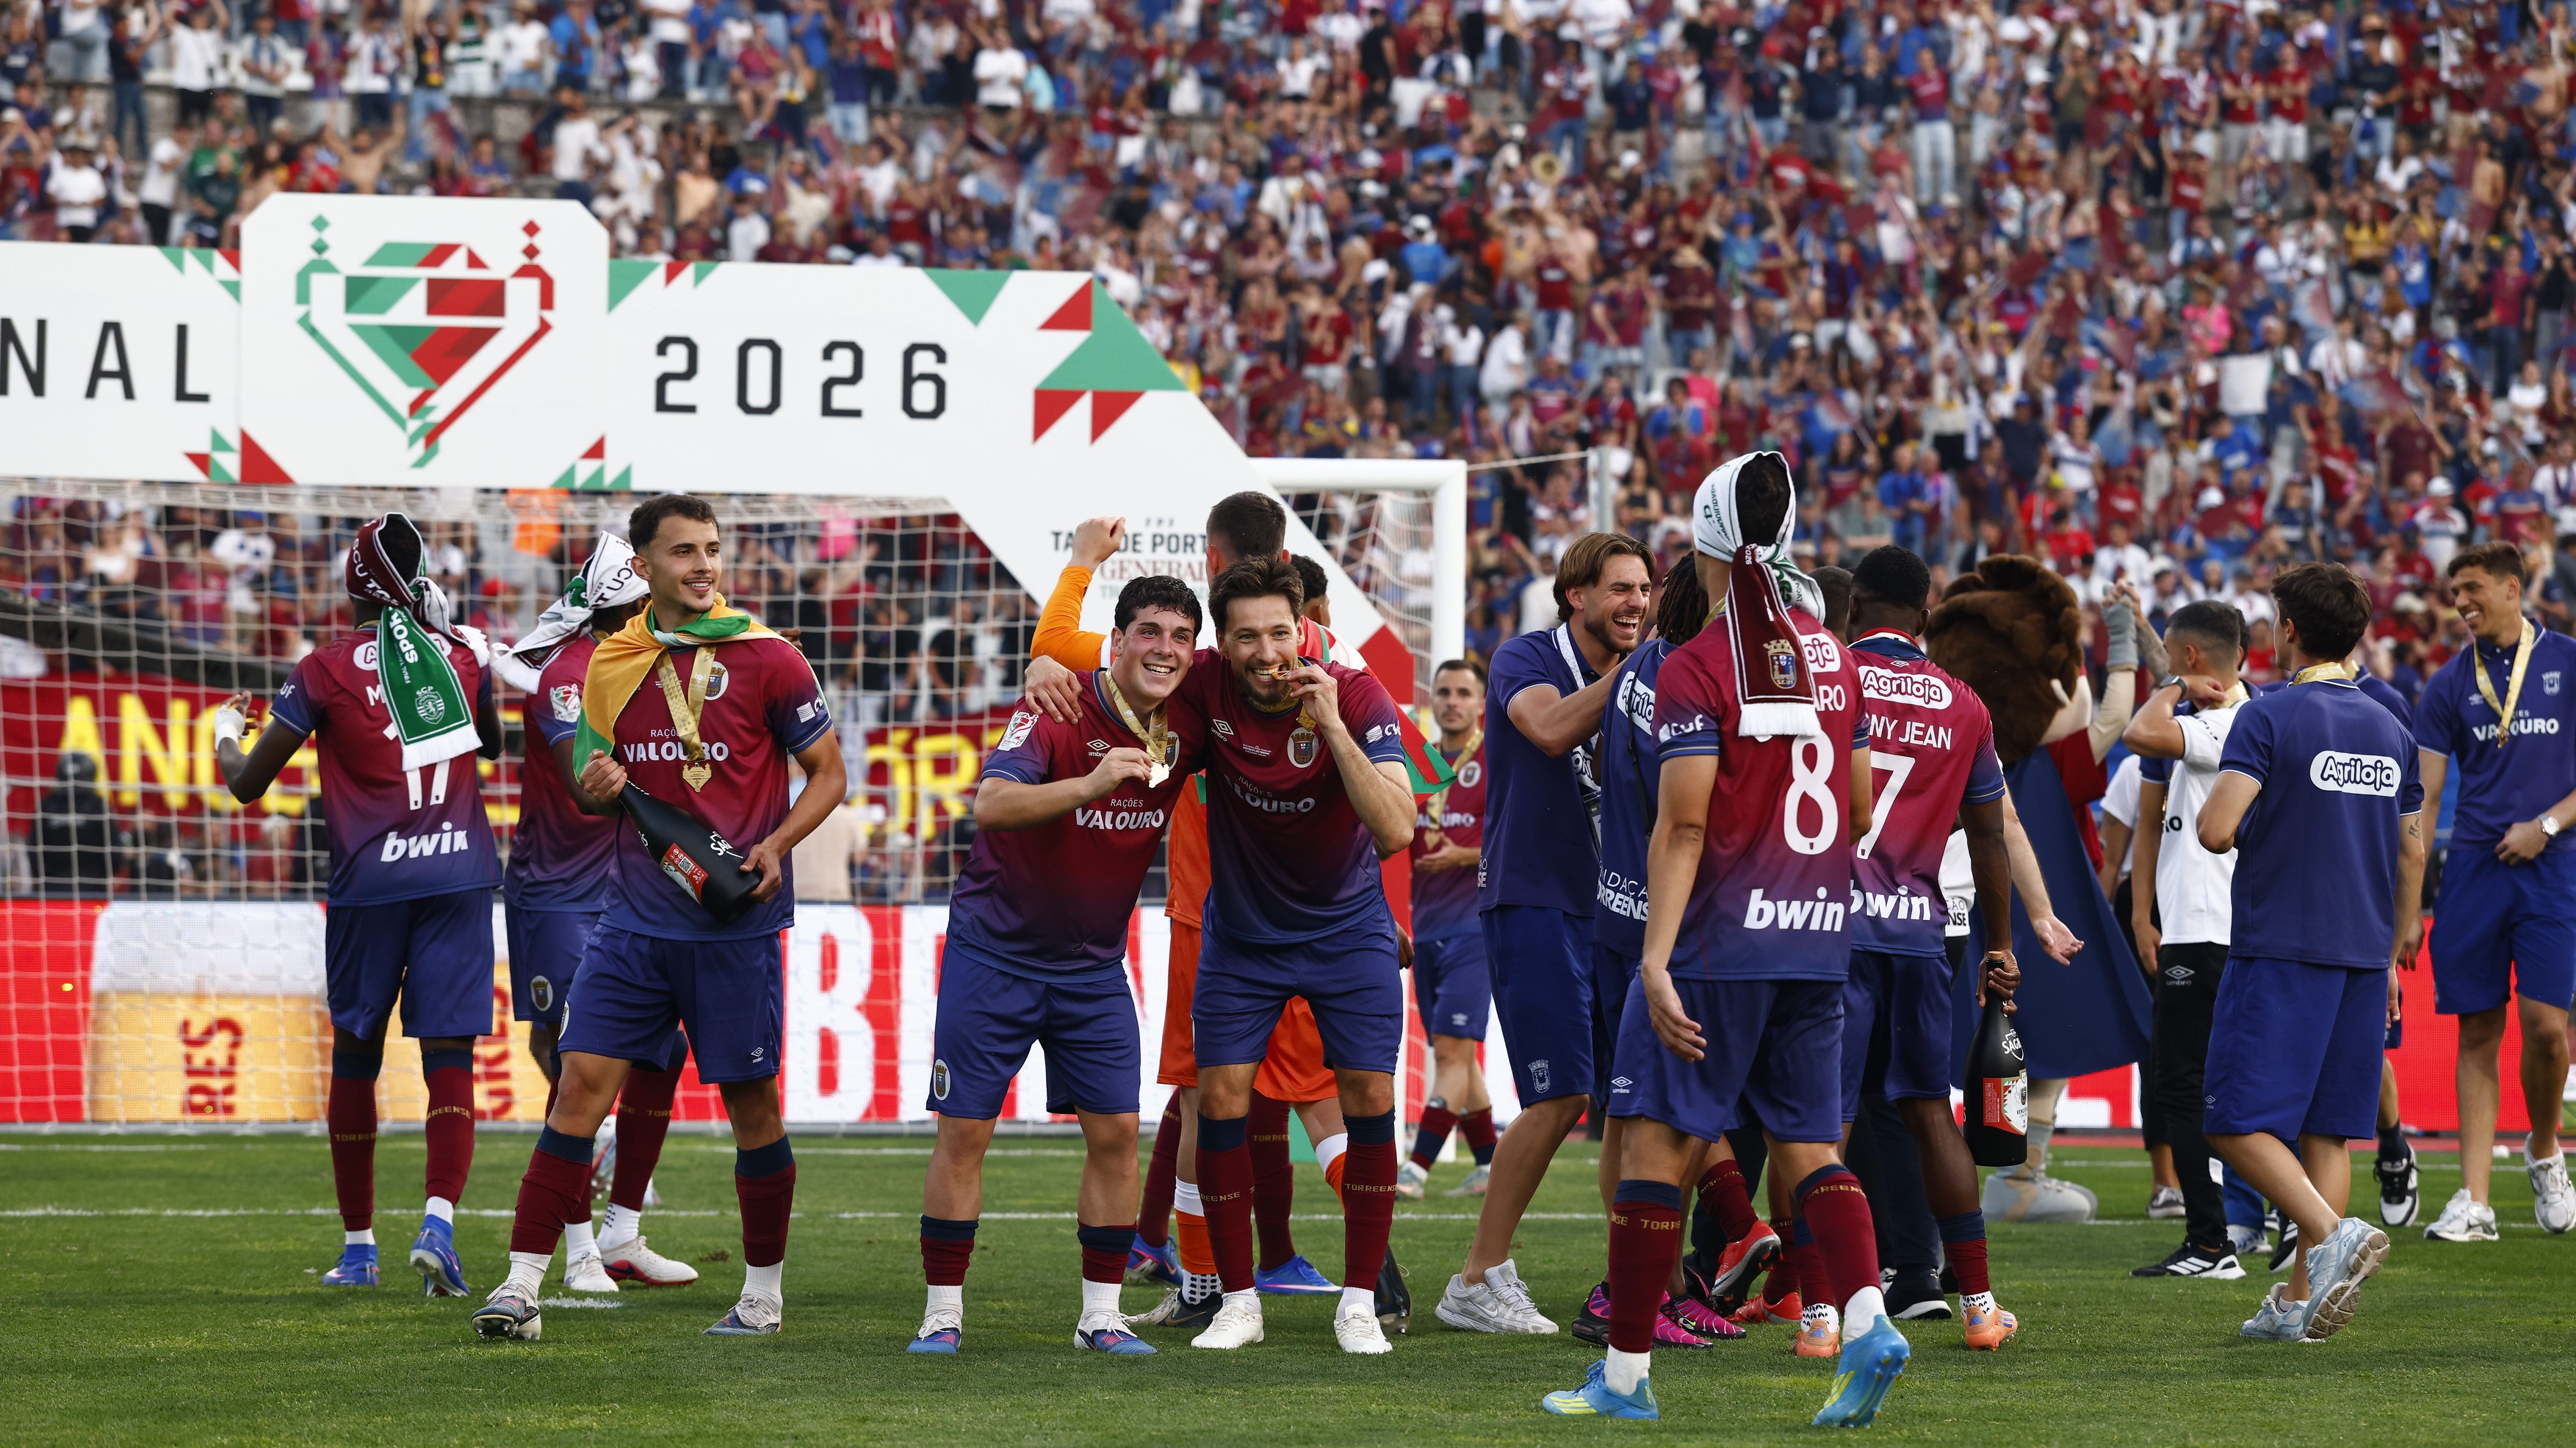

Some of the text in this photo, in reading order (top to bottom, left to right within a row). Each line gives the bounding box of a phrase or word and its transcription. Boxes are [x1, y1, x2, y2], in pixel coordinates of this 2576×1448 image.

[654, 336, 947, 419] 2026
[416, 686, 434, 697] SCP
[1863, 670, 1943, 705] Agriloja
[650, 727, 681, 739] RAÇÕ
[1211, 727, 1228, 742] umbro
[1899, 722, 1952, 750] JEAN
[2472, 718, 2560, 742] VAOURO
[1238, 775, 1273, 797] RAÇÕES
[2320, 756, 2394, 792] Agriloja
[1110, 798, 1144, 809] RAÇÕES
[1783, 729, 1839, 855] 8
[1856, 750, 1916, 860] 7
[1075, 807, 1164, 830] VALOURO
[380, 821, 469, 862] bwin
[1743, 886, 1845, 932] bwin
[1850, 879, 1931, 921] bwin
[1344, 1183, 1398, 1193] TORREENSE
